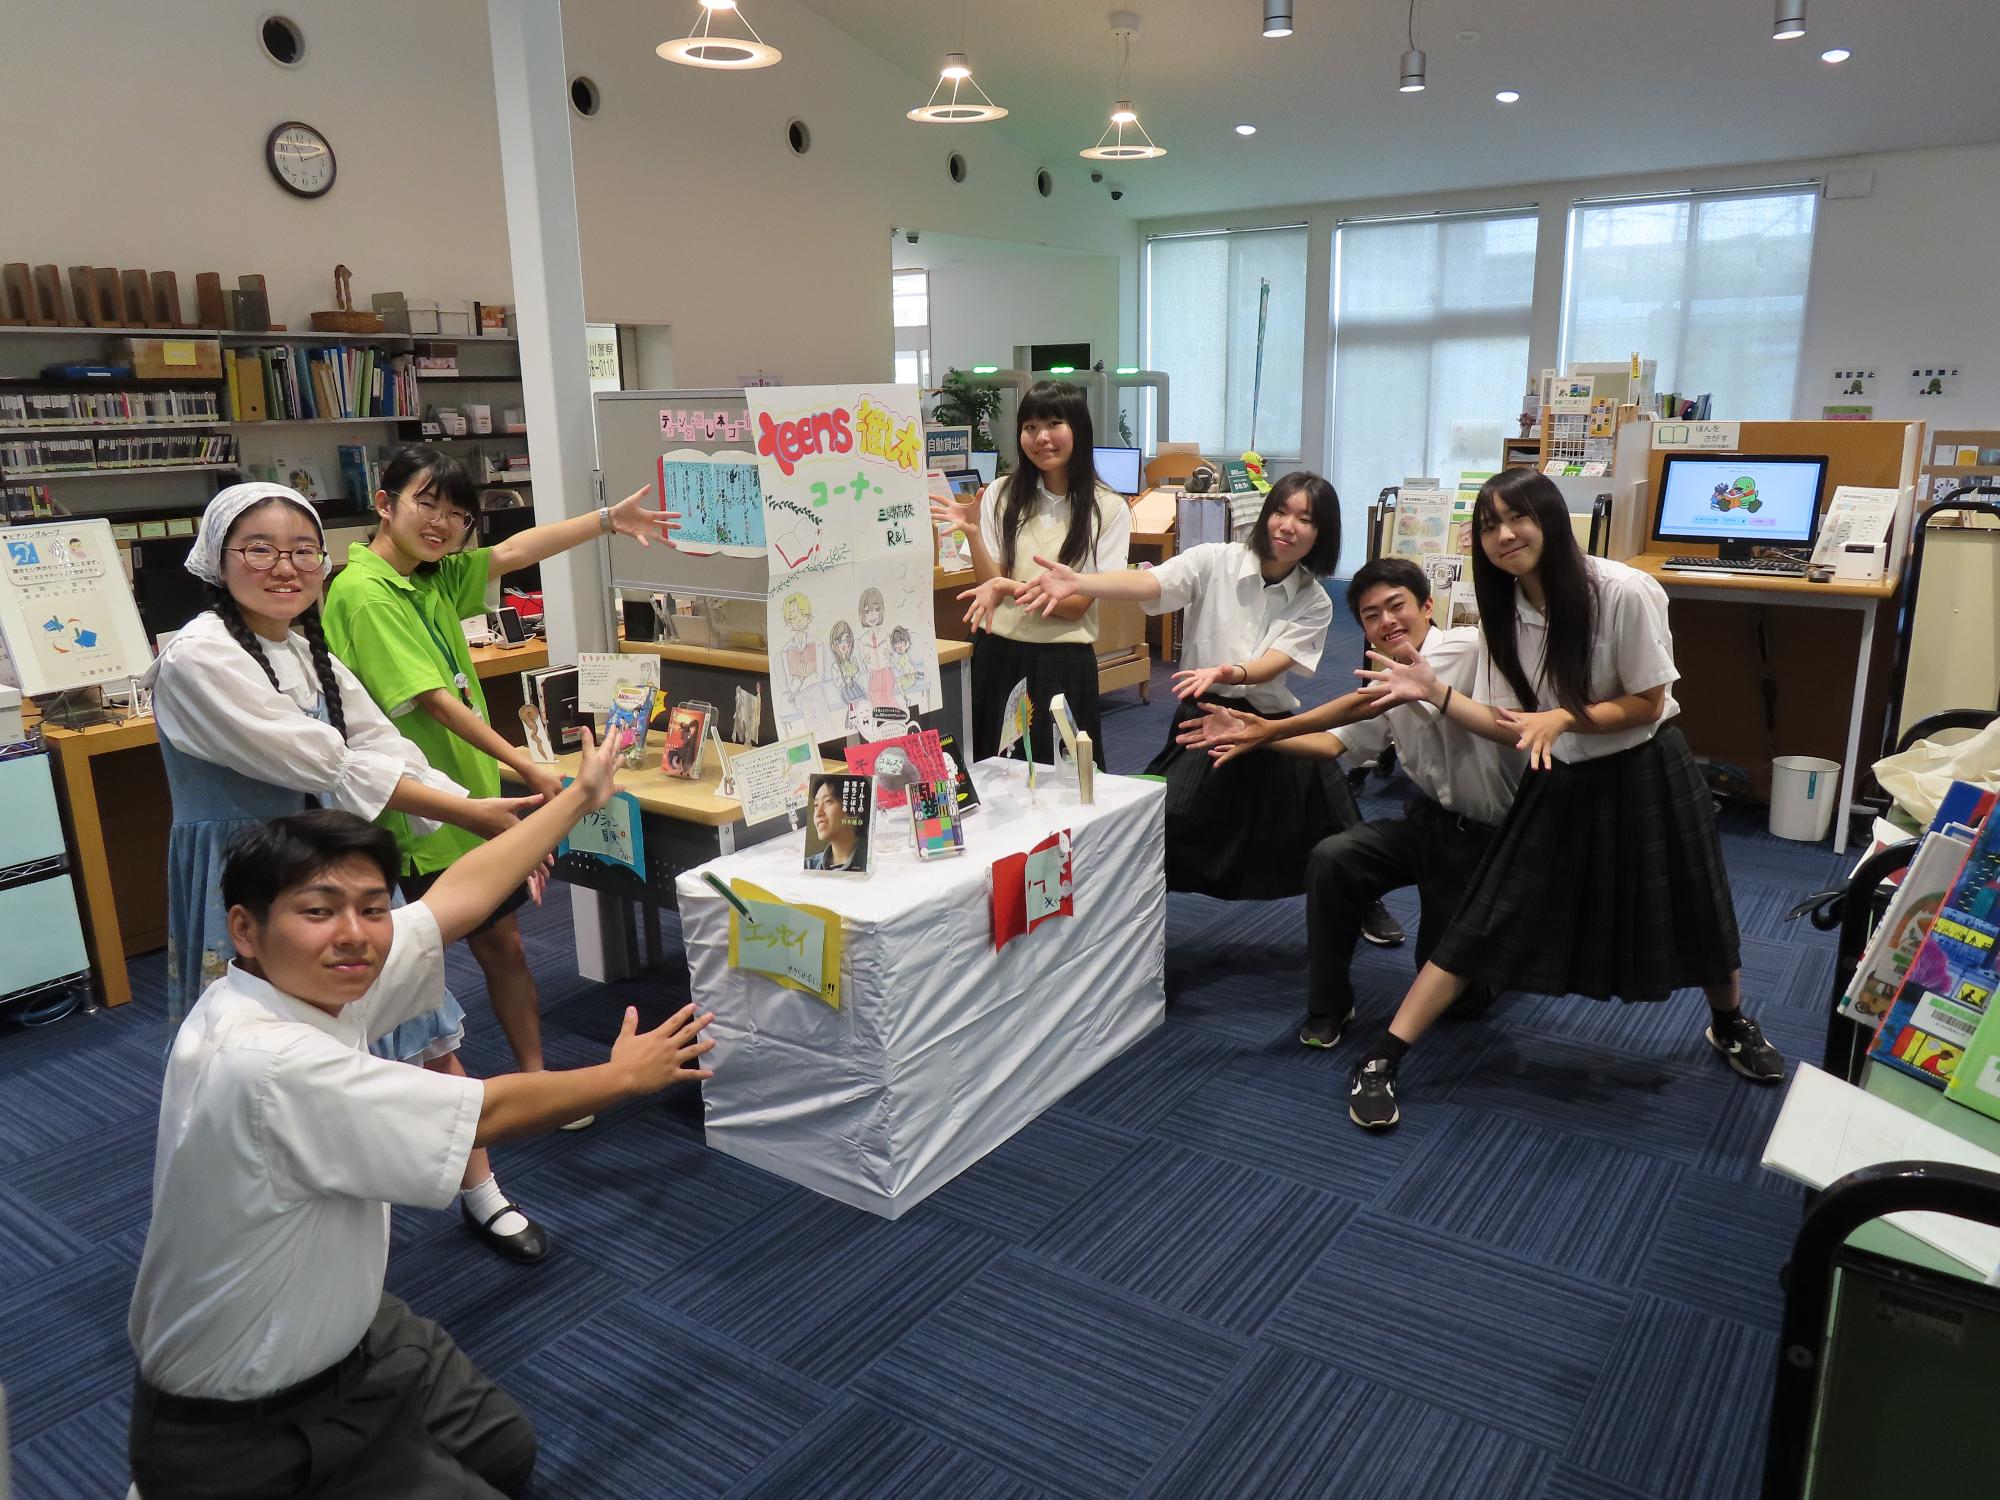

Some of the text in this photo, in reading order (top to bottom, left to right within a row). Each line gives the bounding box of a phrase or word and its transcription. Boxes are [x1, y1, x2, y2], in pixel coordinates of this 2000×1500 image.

[587, 343, 614, 357] 川警察
[809, 471, 884, 508] コーナー
[744, 922, 809, 957] エッセイ
